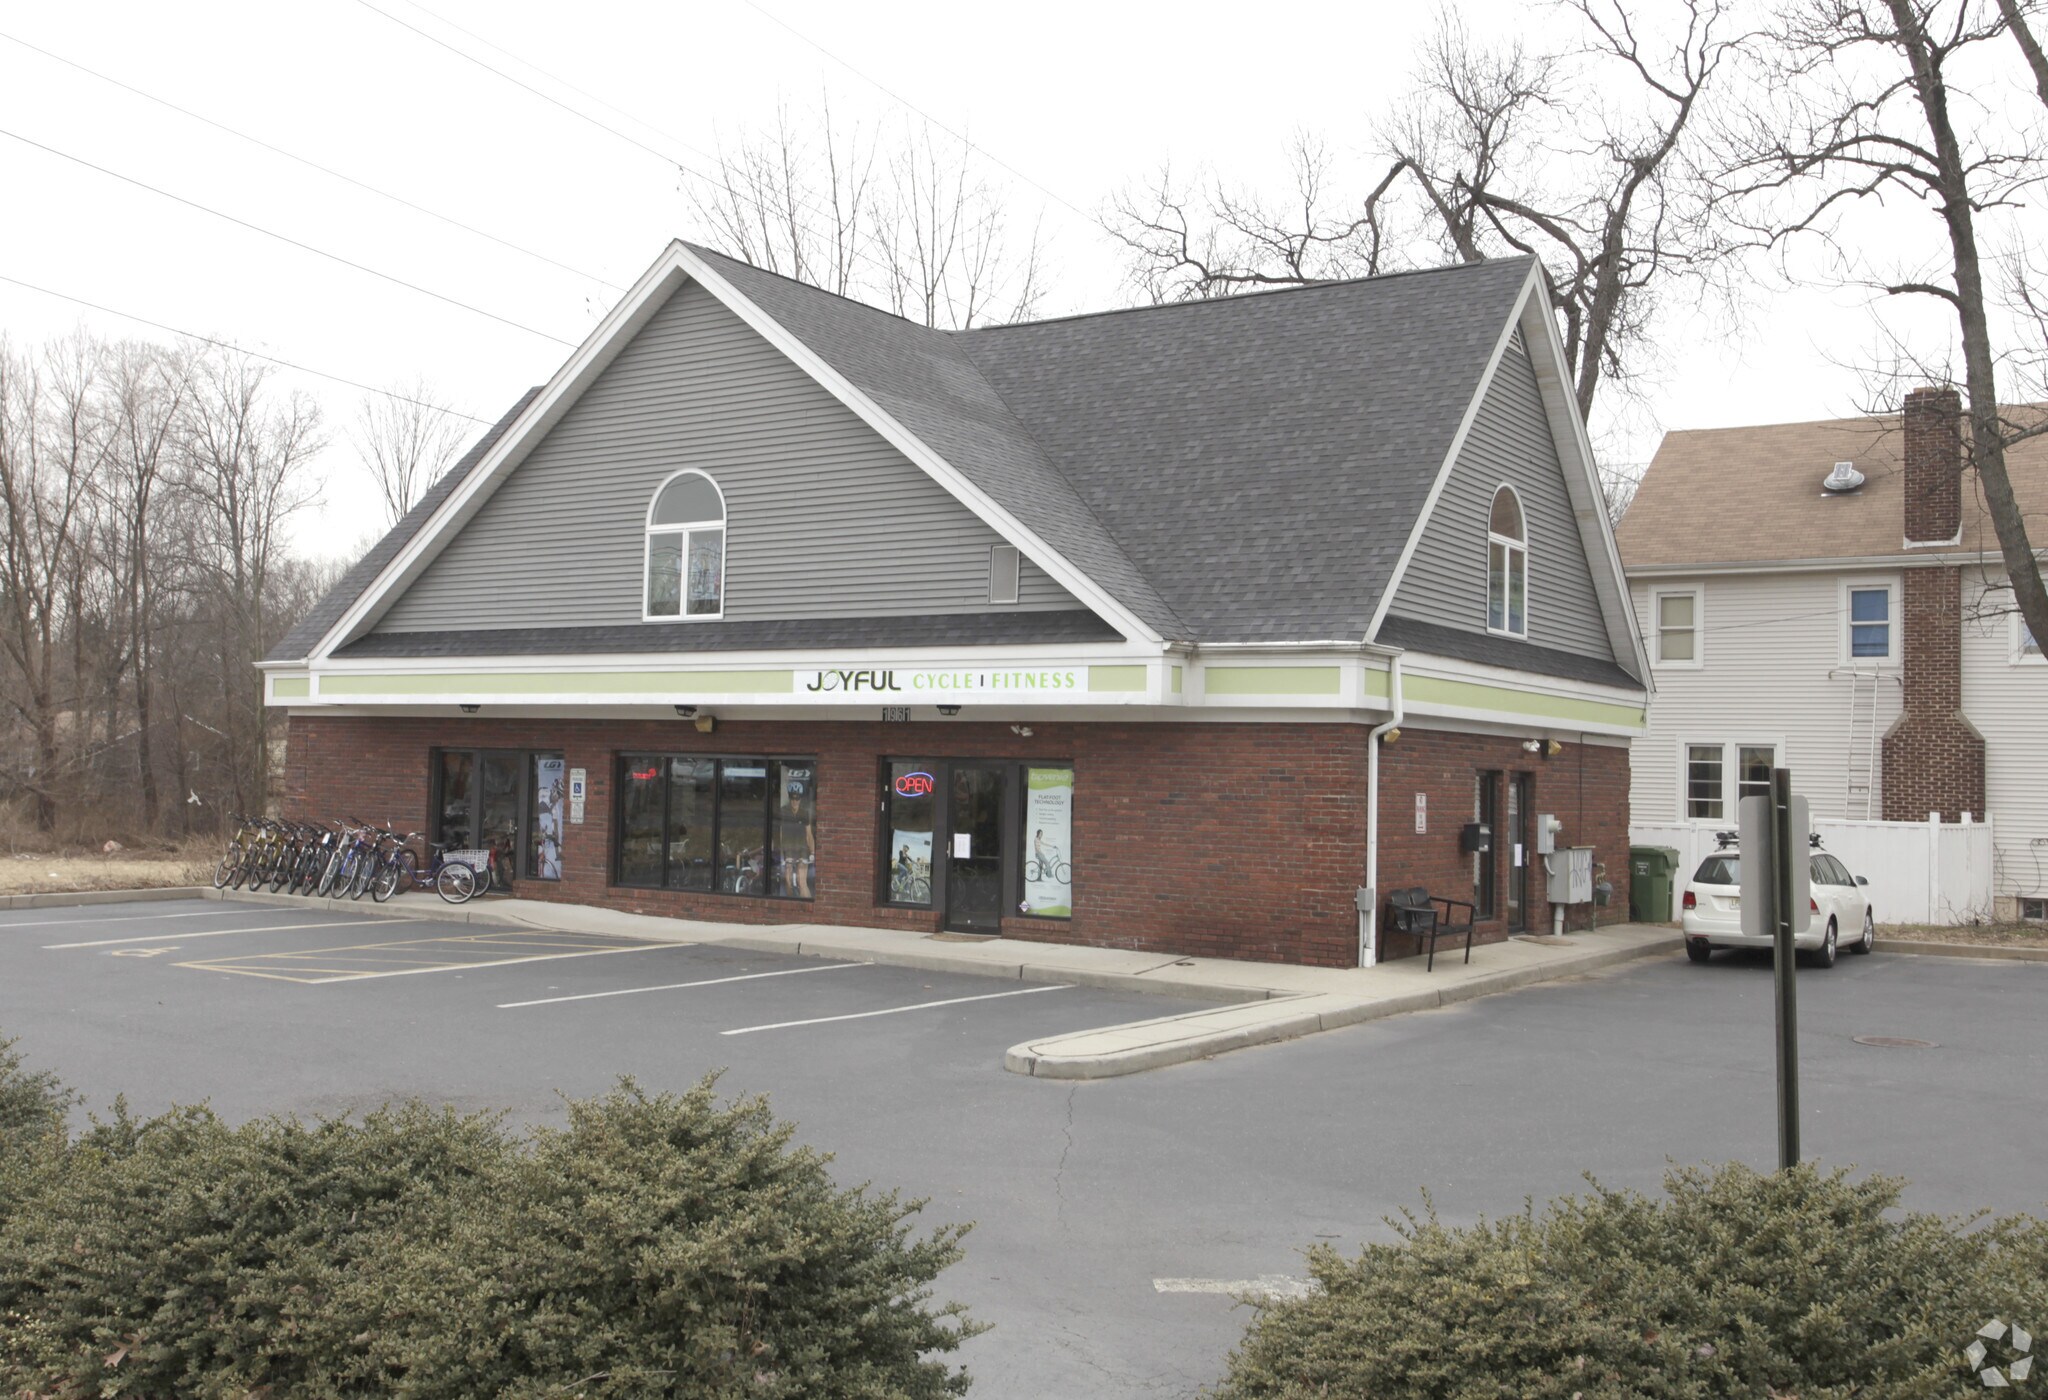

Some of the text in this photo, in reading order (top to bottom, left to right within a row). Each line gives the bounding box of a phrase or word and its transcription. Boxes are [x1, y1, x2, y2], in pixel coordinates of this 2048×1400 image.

[806, 669, 1075, 691] JOYFUL CYCLE FITNESS
[882, 706, 911, 721] 1961
[895, 776, 933, 793] OPEN
